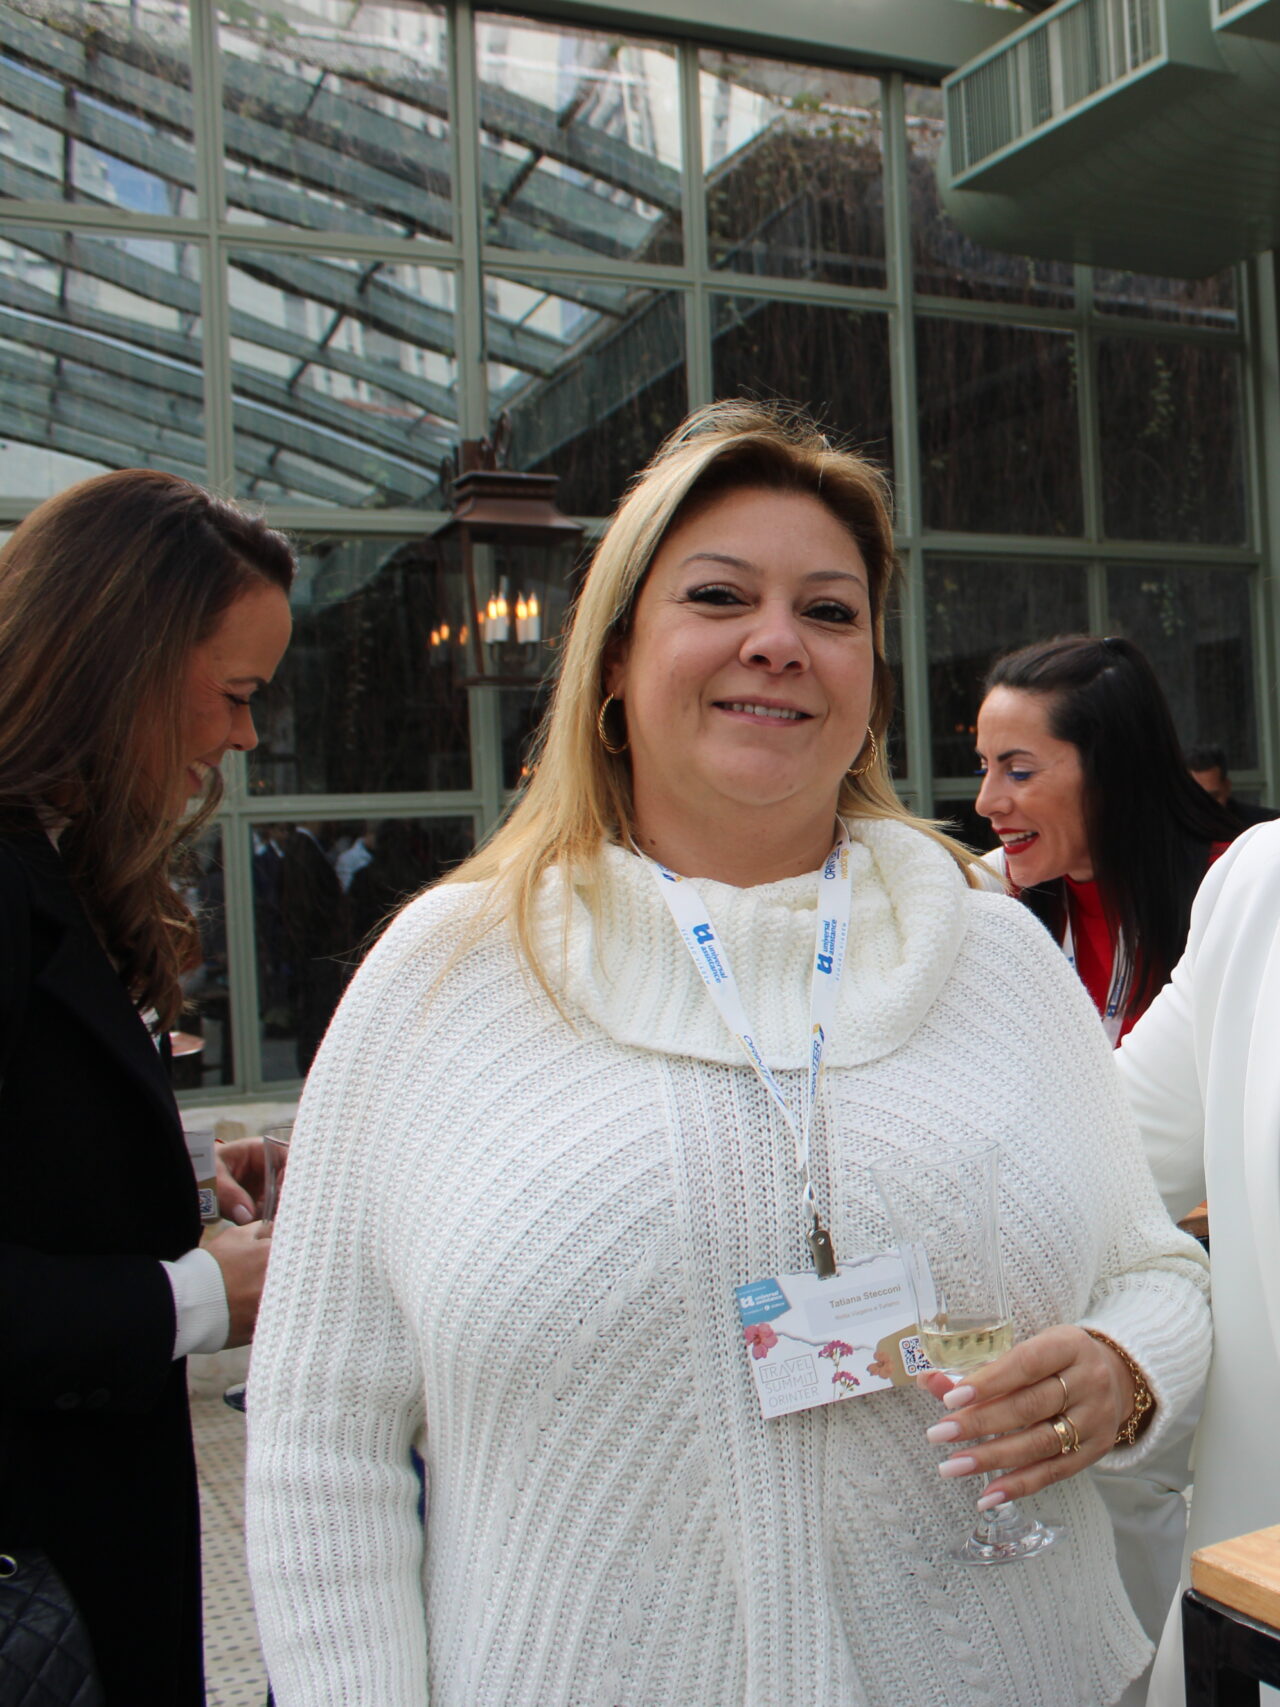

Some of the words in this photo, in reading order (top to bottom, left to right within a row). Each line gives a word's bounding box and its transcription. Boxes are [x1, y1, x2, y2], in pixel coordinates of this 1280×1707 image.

[822, 920, 830, 952] universal
[829, 919, 837, 955] assistance
[700, 945, 723, 984] assistance
[707, 944, 728, 980] universal
[829, 1295, 861, 1308] Tatiana
[863, 1284, 902, 1300] Stecconi
[762, 1360, 812, 1379] TRAVEL
[765, 1371, 813, 1393] SUMMIT
[769, 1386, 819, 1408] ORINTER
